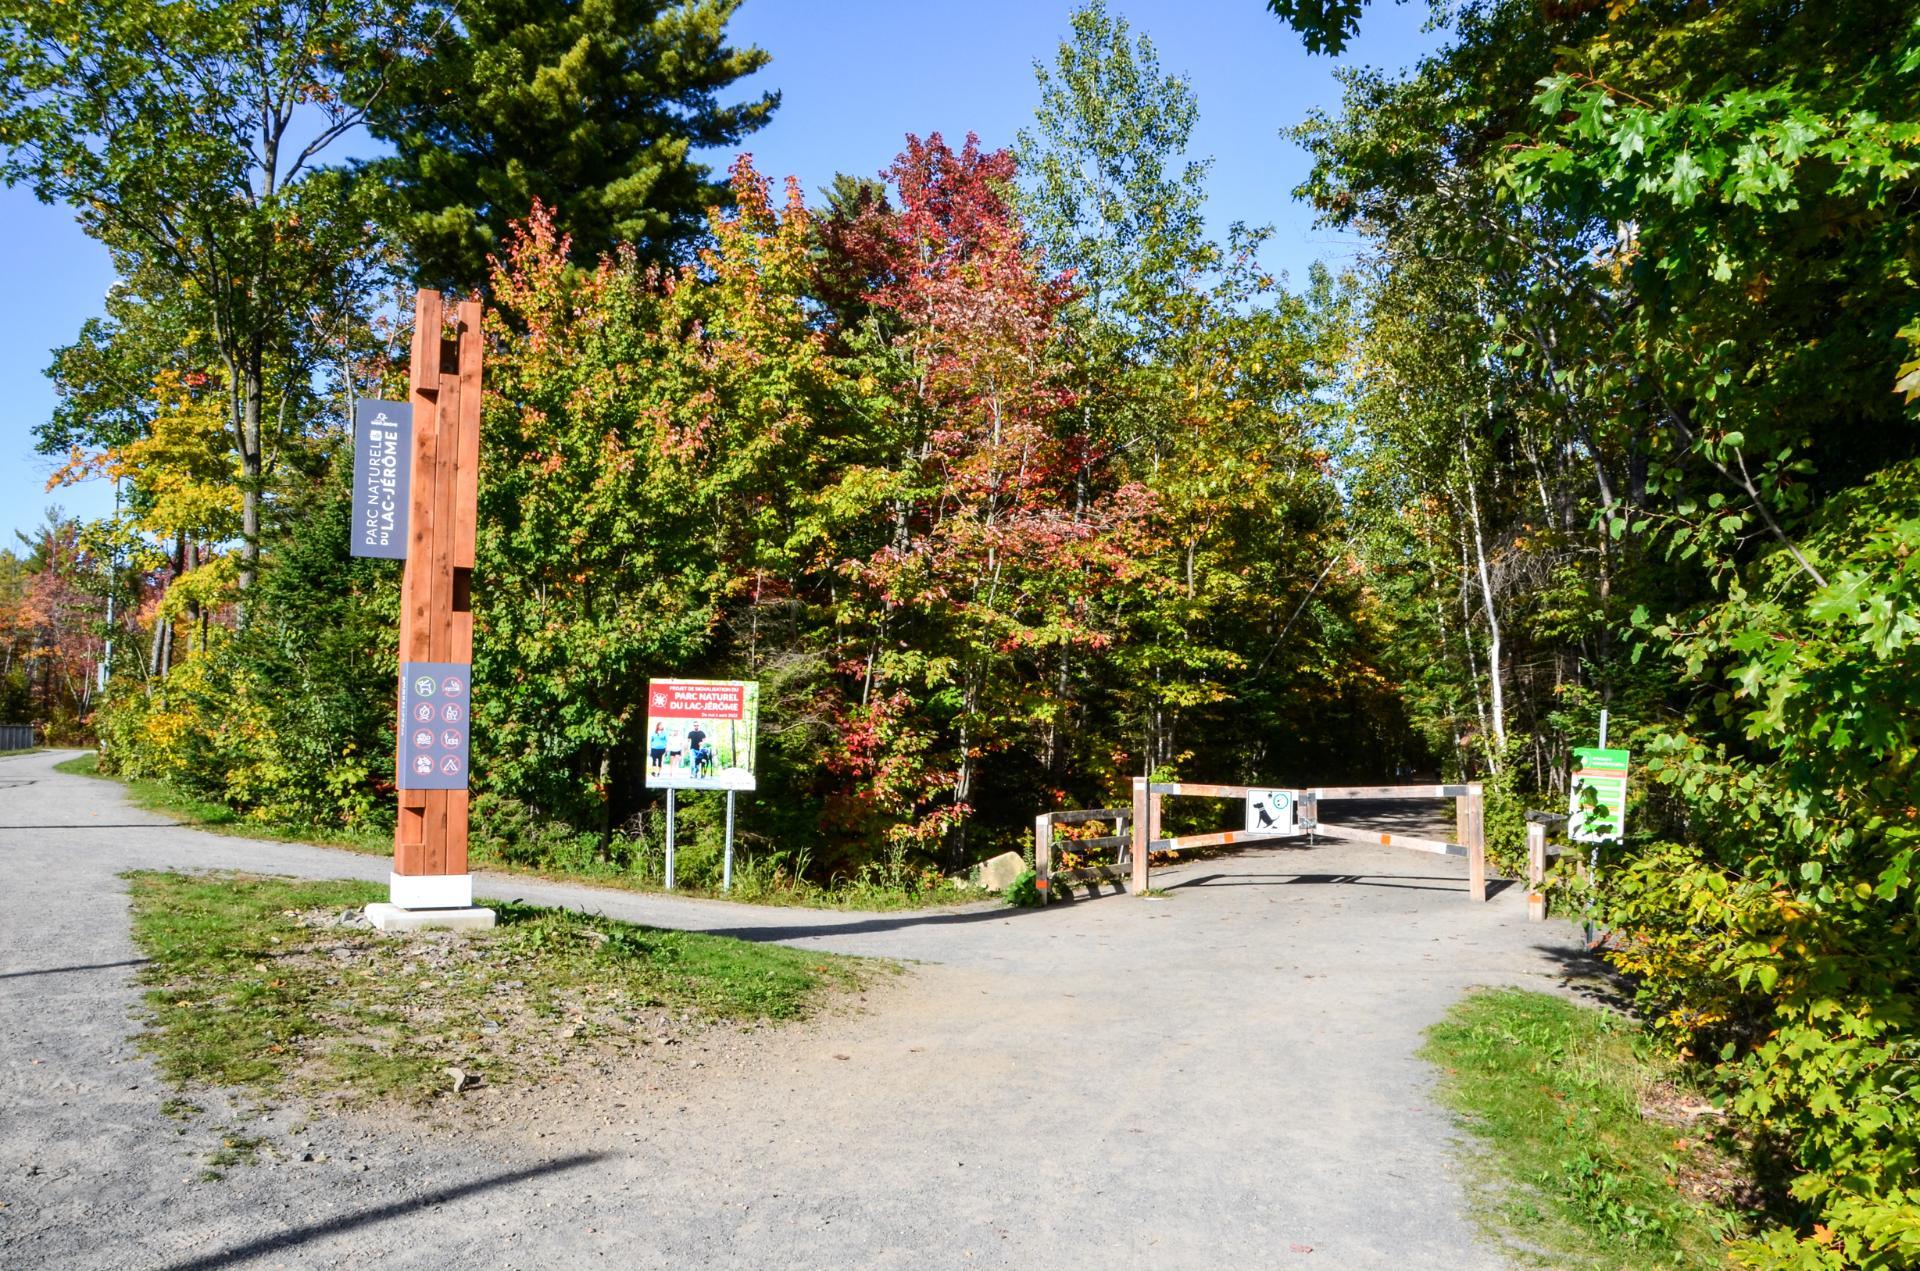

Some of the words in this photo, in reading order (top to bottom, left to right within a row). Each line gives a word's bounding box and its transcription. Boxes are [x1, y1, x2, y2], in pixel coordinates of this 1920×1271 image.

[368, 443, 382, 505] NATUREL
[381, 431, 398, 531] LAC-JÉRÔME
[366, 509, 379, 545] PARC
[380, 533, 388, 546] DU
[685, 702, 738, 711] LAC-JÉRÔME
